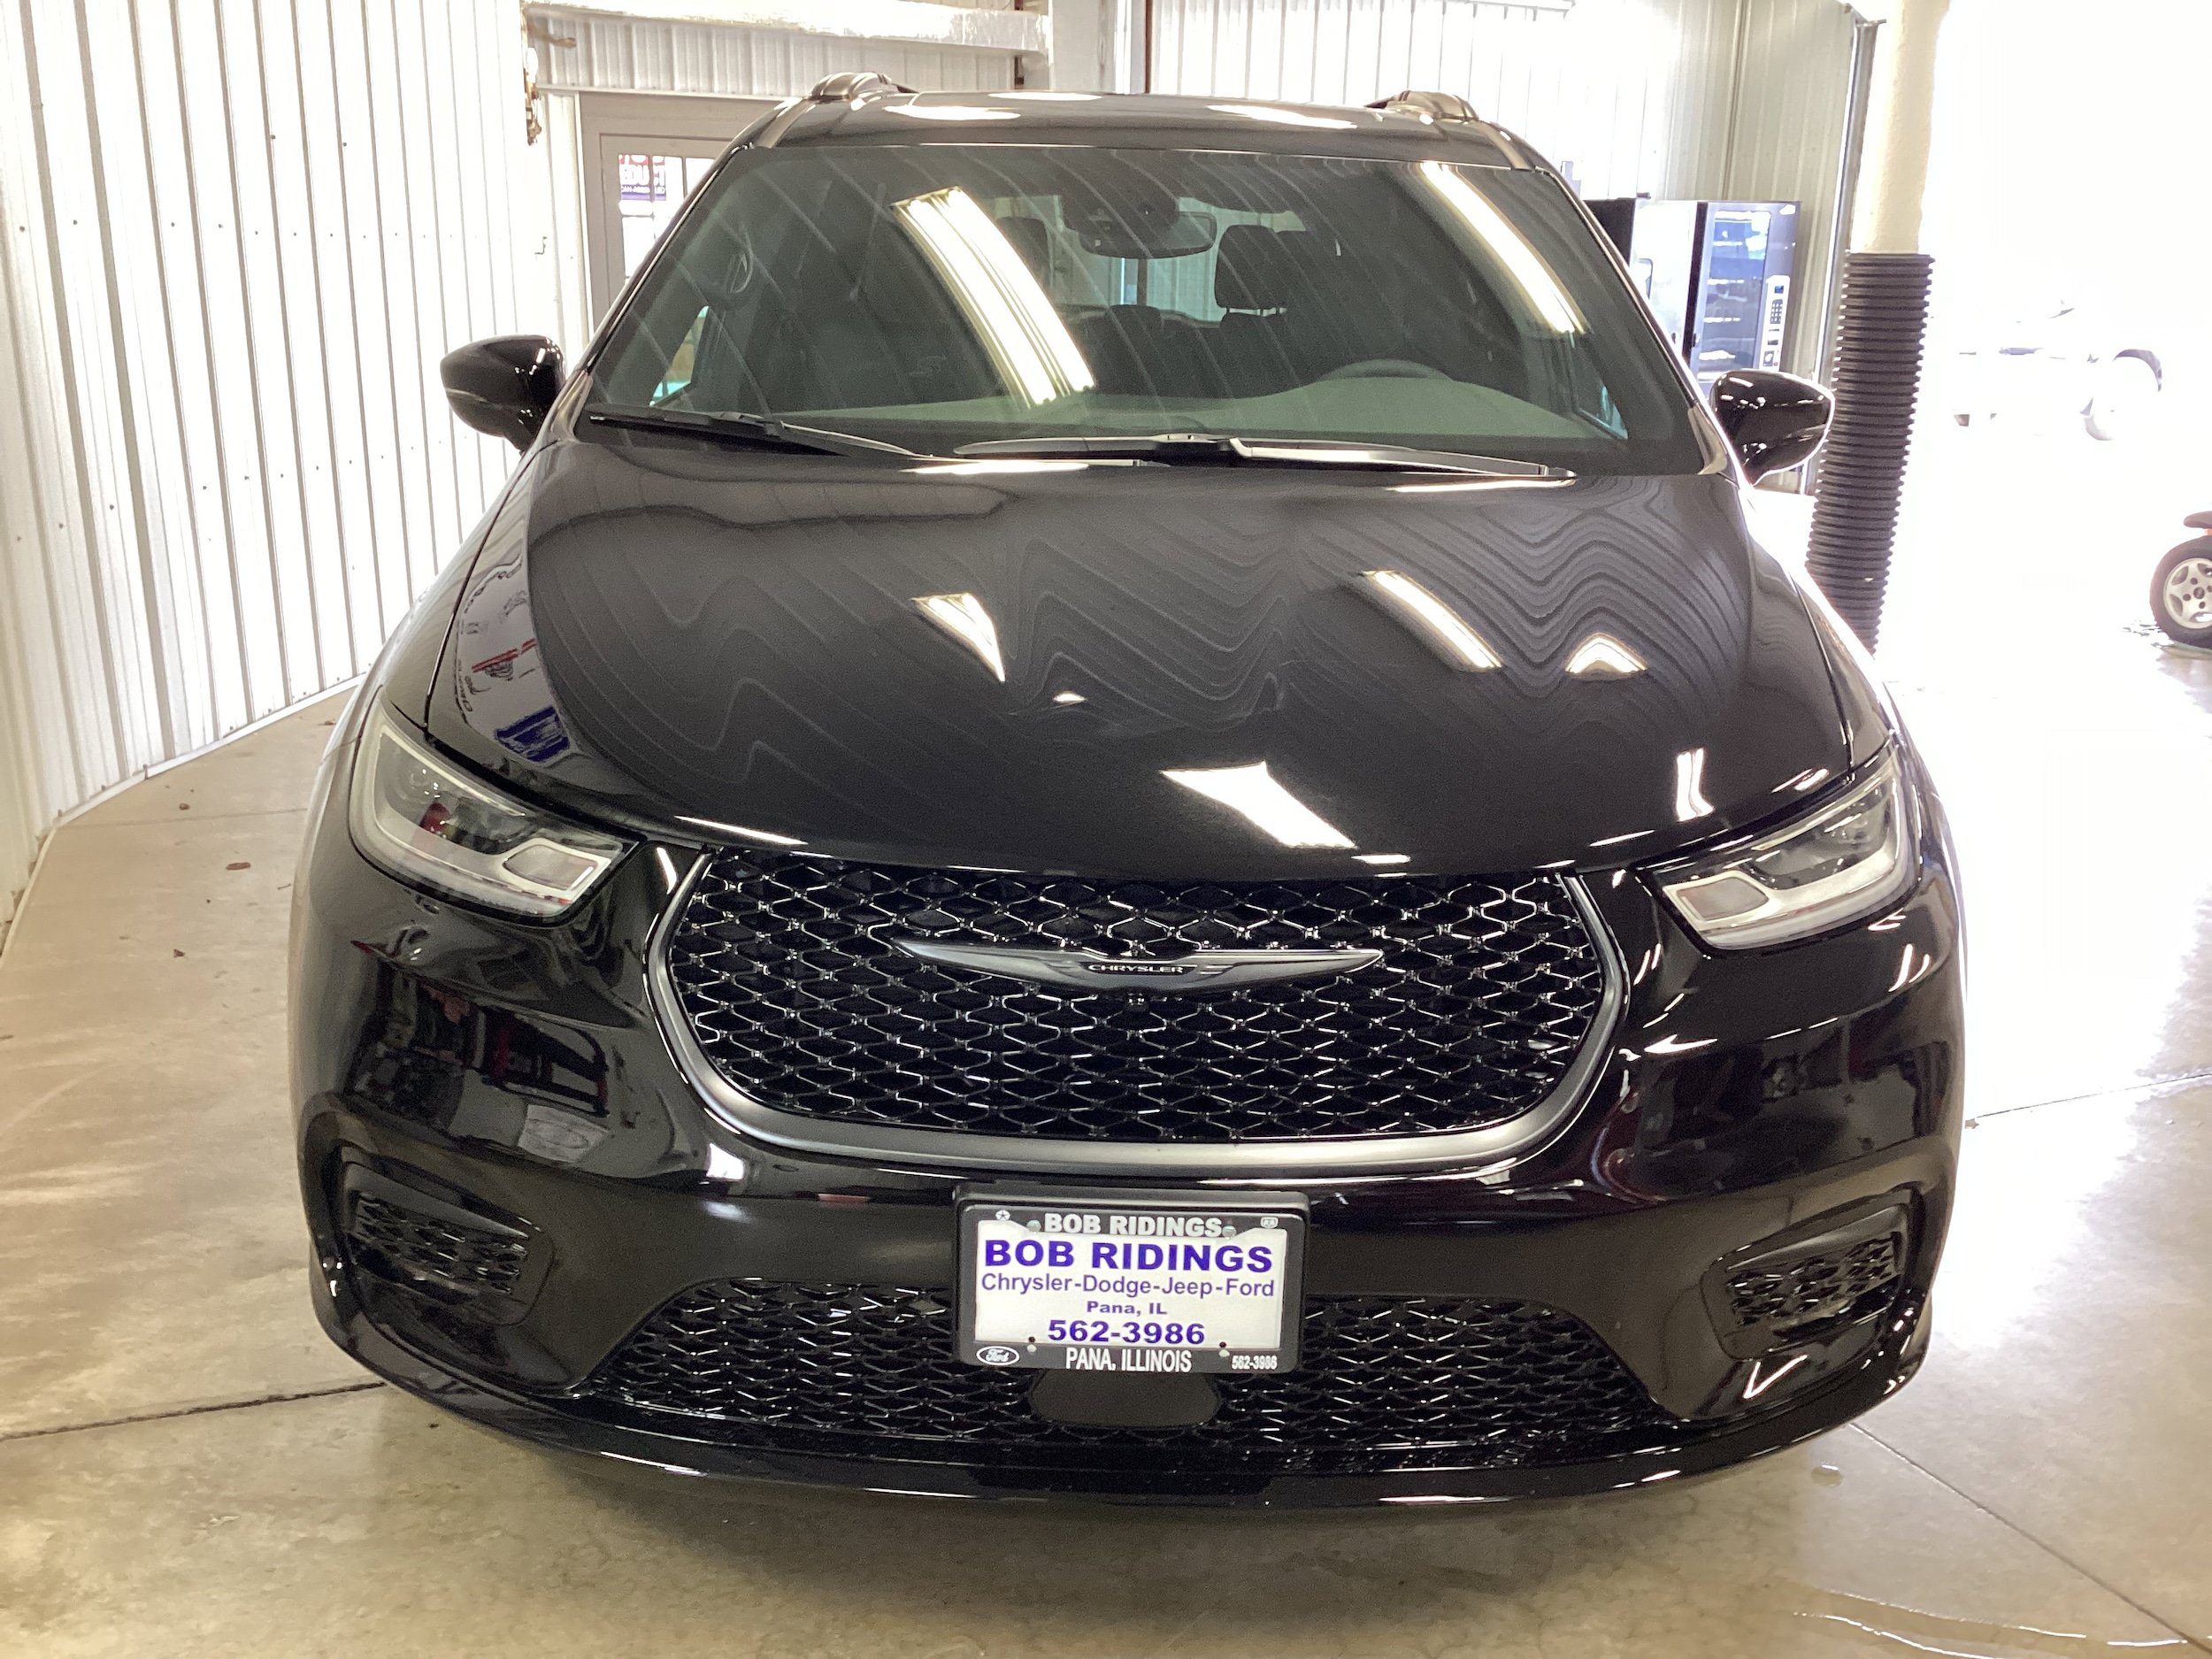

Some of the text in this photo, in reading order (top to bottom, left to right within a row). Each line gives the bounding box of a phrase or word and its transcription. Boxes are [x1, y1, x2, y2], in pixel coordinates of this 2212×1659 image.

[1088, 964, 1184, 973] CHRYSLER
[1045, 1212, 1222, 1238] BOB RIDINGS
[985, 1240, 1272, 1272] BOB RIDINGS
[981, 1272, 1275, 1298] Chrysler-Dodge-Jeep-Ford
[1087, 1301, 1168, 1317] Pana, IL
[1048, 1319, 1205, 1345] 562-3986
[1121, 1348, 1192, 1372] ILLINOIS
[1231, 1355, 1278, 1370] 562-3986
